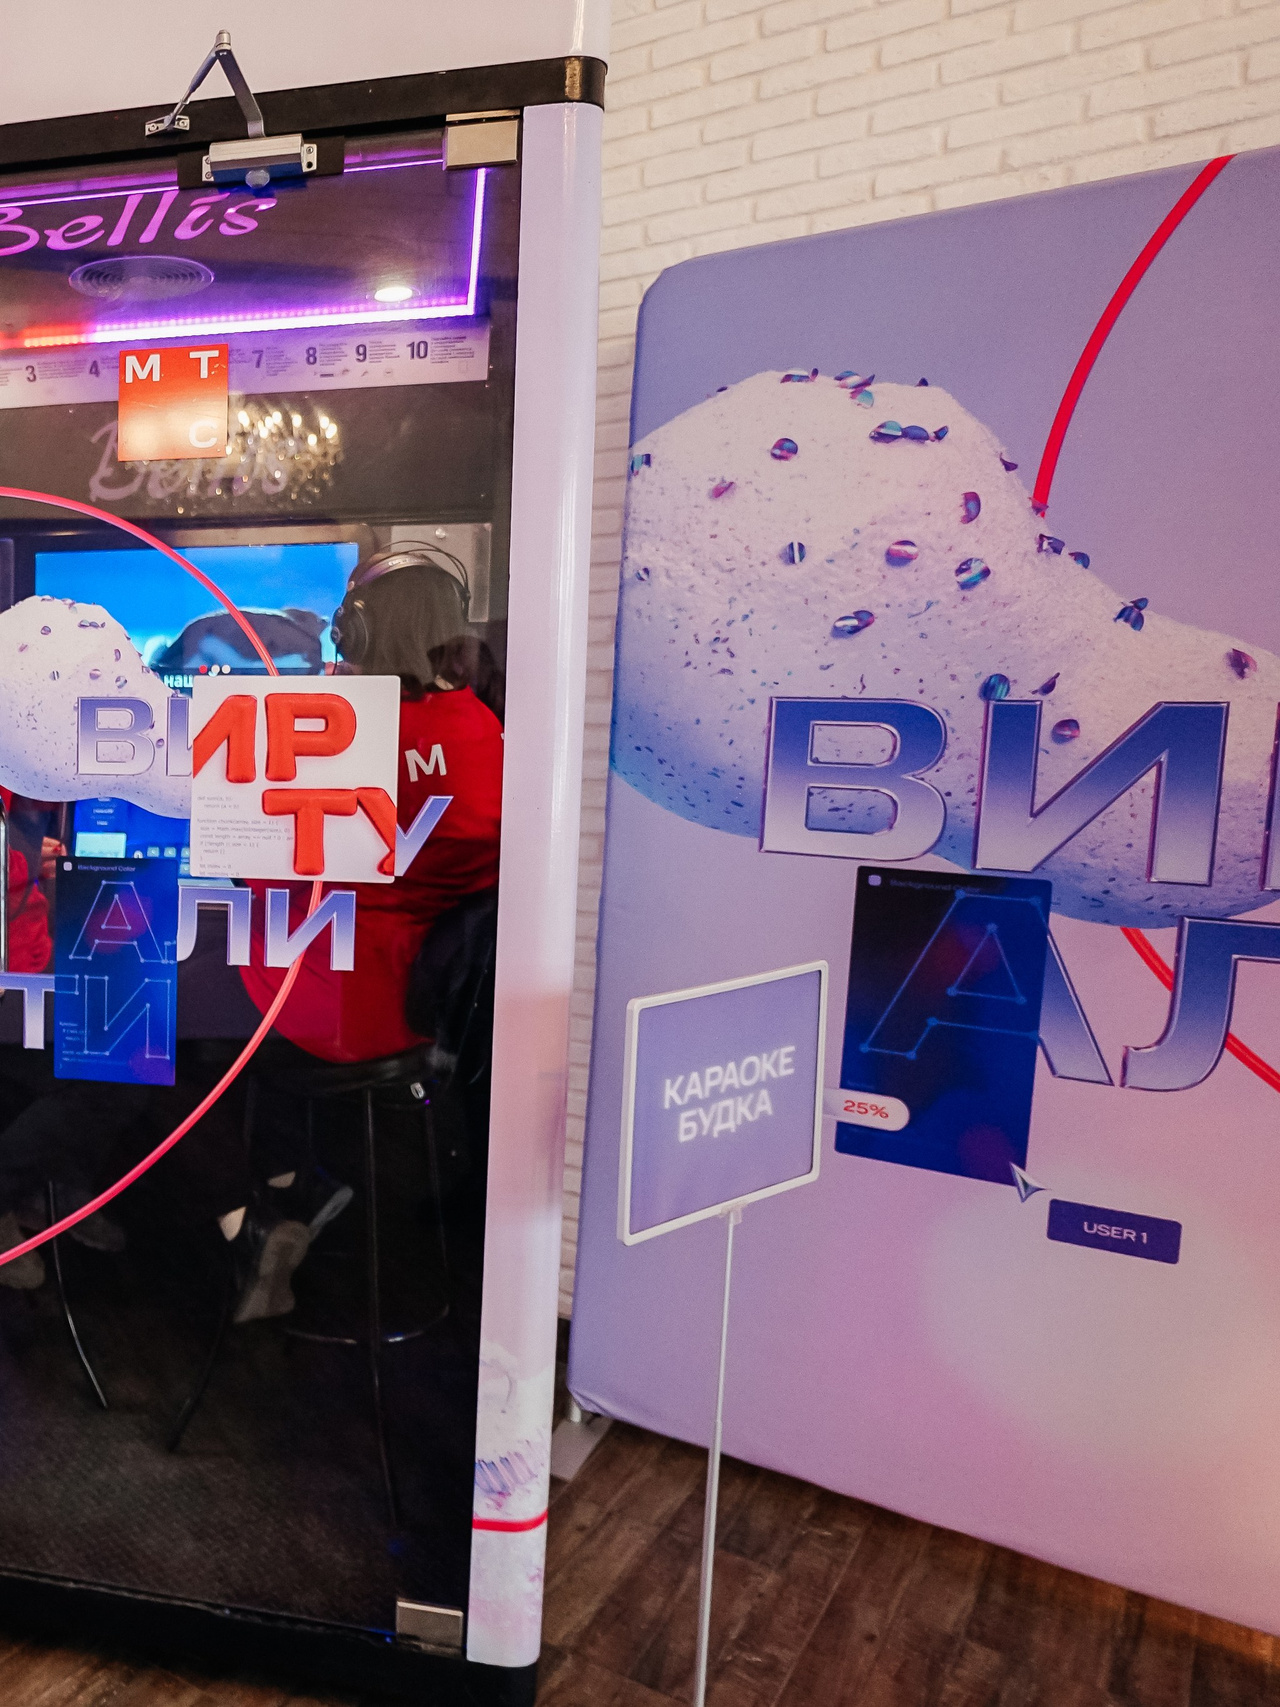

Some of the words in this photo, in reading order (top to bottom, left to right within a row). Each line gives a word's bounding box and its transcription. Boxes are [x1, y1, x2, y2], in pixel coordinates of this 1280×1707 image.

[252, 349, 264, 368] 7
[305, 346, 317, 365] 8
[355, 344, 367, 362] 9
[406, 340, 428, 360] 10
[25, 365, 37, 382] 3
[89, 360, 101, 377] 4
[759, 695, 1280, 892] ВИ
[663, 1045, 796, 1110] КАРАОКЕ
[678, 1088, 773, 1143] БУДКА
[843, 1099, 889, 1119] 25%
[1083, 1221, 1137, 1242] USER
[1140, 1232, 1148, 1244] 1
